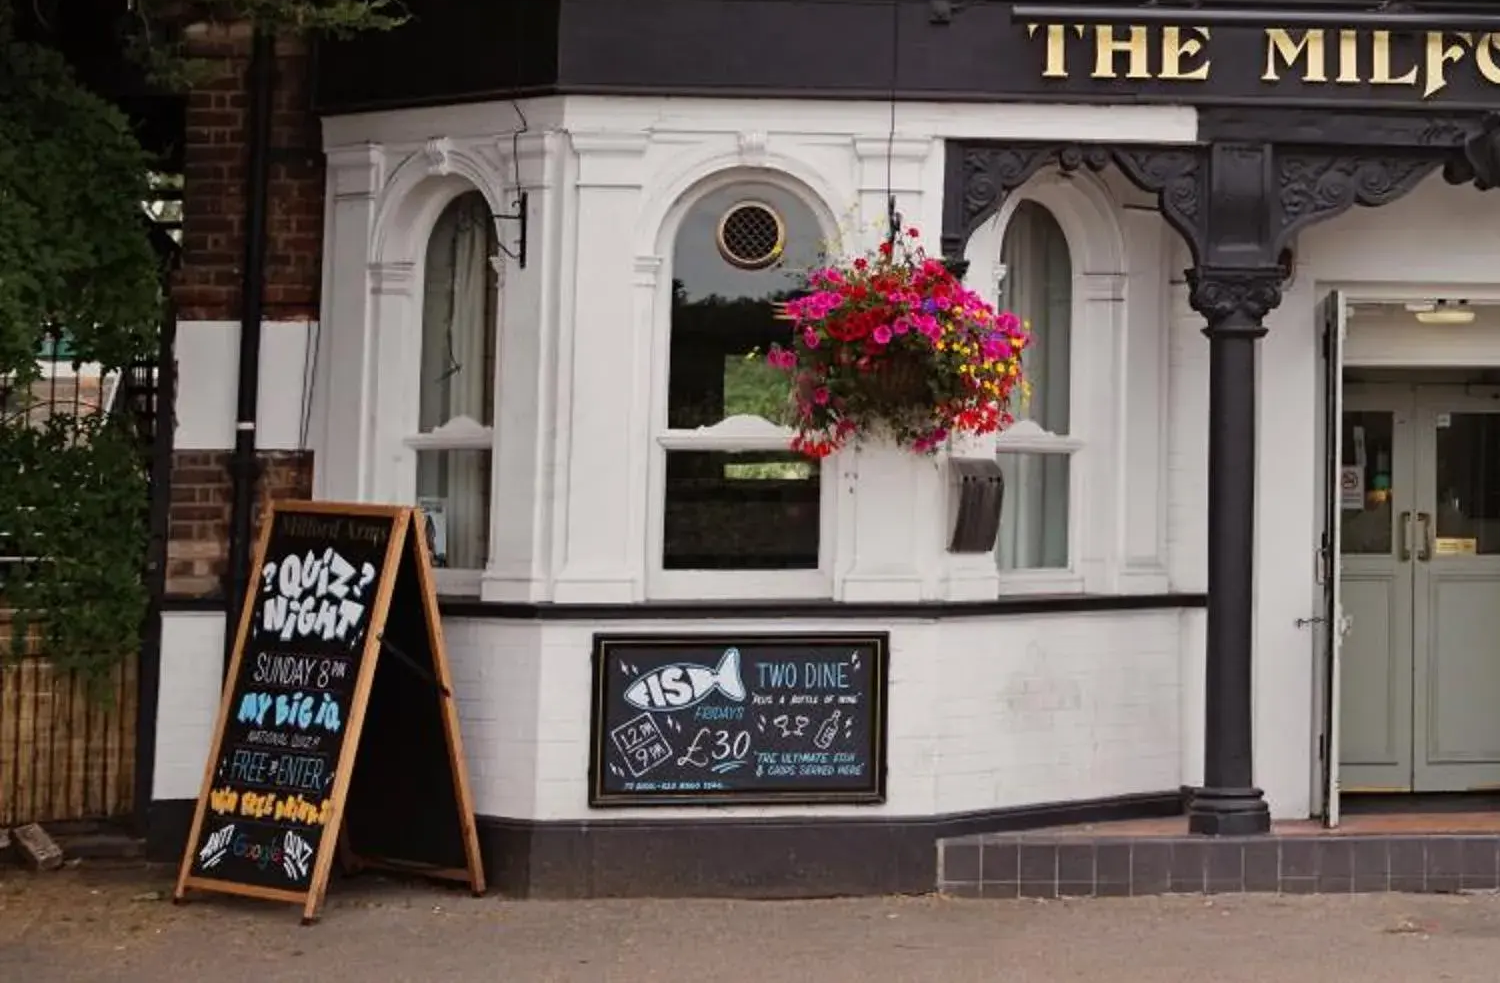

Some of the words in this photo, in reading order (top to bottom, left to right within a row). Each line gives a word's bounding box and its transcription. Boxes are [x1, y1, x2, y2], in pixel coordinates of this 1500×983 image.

[1028, 23, 1211, 80] THE
[253, 652, 317, 685] SUNDAY
[755, 662, 798, 688] TWO
[804, 662, 850, 689] DINE
[677, 728, 751, 767] £30
[230, 749, 269, 783] FREE
[276, 756, 325, 790] ENTER
